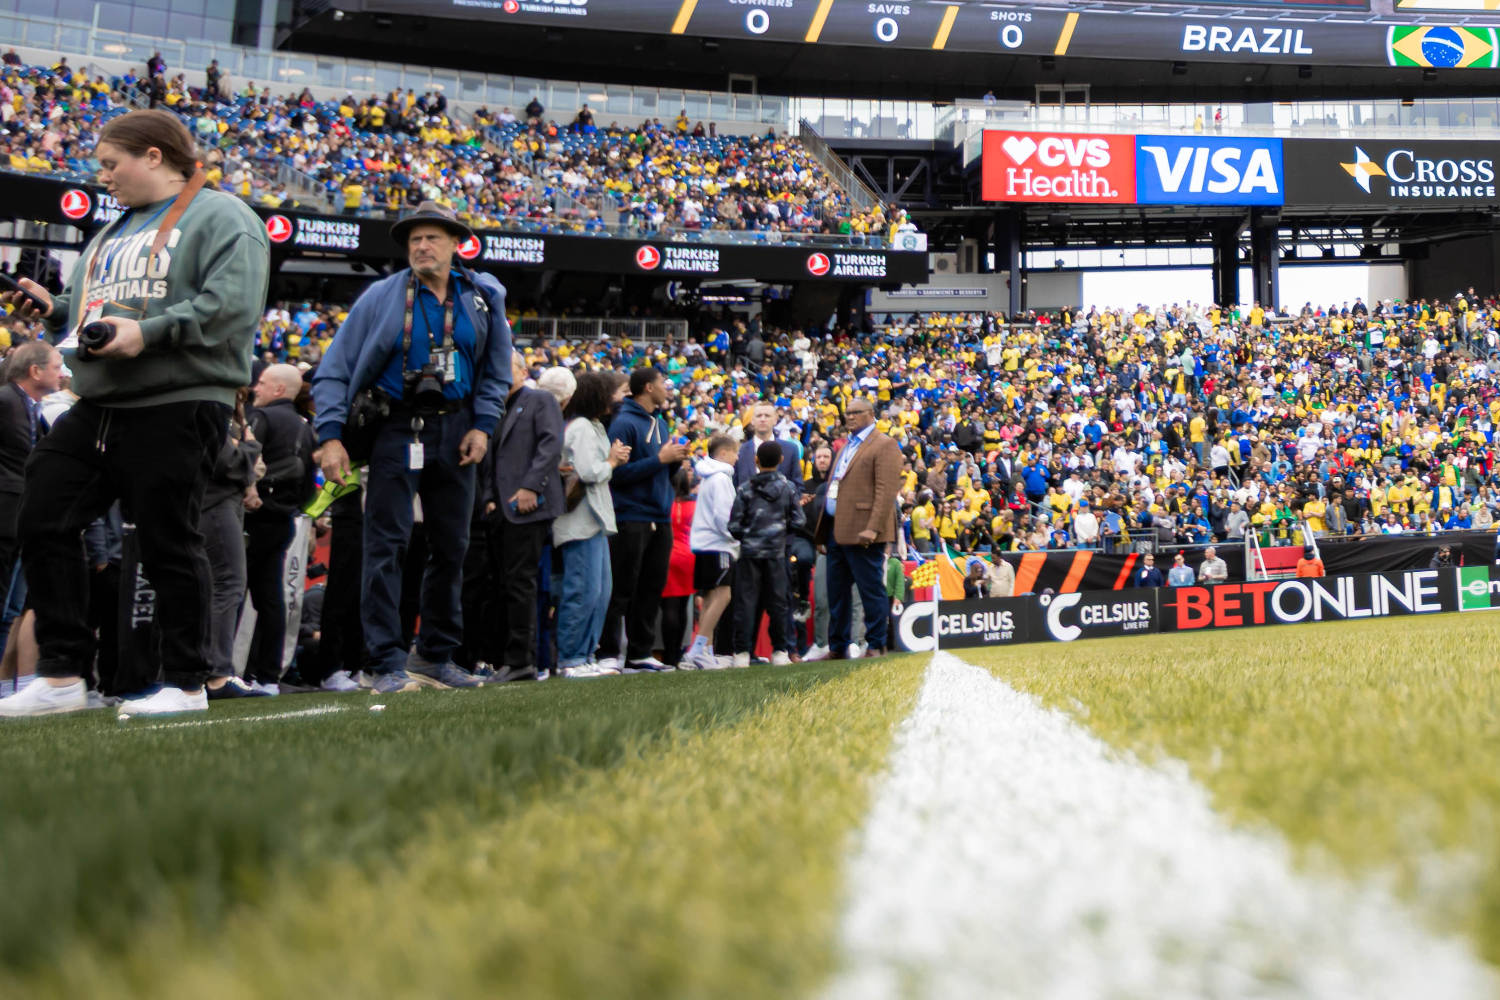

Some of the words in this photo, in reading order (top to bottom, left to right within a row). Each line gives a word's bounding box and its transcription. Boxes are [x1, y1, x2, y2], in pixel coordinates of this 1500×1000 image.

[868, 4, 910, 16] SAVES
[991, 11, 1032, 22] SHOTS
[746, 9, 770, 34] 0
[876, 18, 898, 42] 0
[1001, 24, 1023, 48] 0
[1182, 25, 1313, 55] BRAZIL
[1037, 137, 1110, 167] CVS
[1141, 145, 1279, 195] VISA
[1390, 185, 1496, 197] INSURANCE
[297, 219, 360, 236] TURKISH
[295, 231, 360, 249] AIRLINES
[484, 235, 545, 252] TURKISH
[483, 248, 545, 264] AIRLINES
[665, 247, 720, 261] TURKISH
[834, 254, 886, 267] TURKISH
[662, 257, 720, 272] AIRLINES
[833, 264, 886, 278] AIRLINES
[1163, 571, 1442, 629] BETONLINE
[1123, 621, 1138, 630] LIVE
[1140, 620, 1149, 629] FIT
[984, 632, 1000, 641] LIVE
[1001, 631, 1013, 640] FIT
